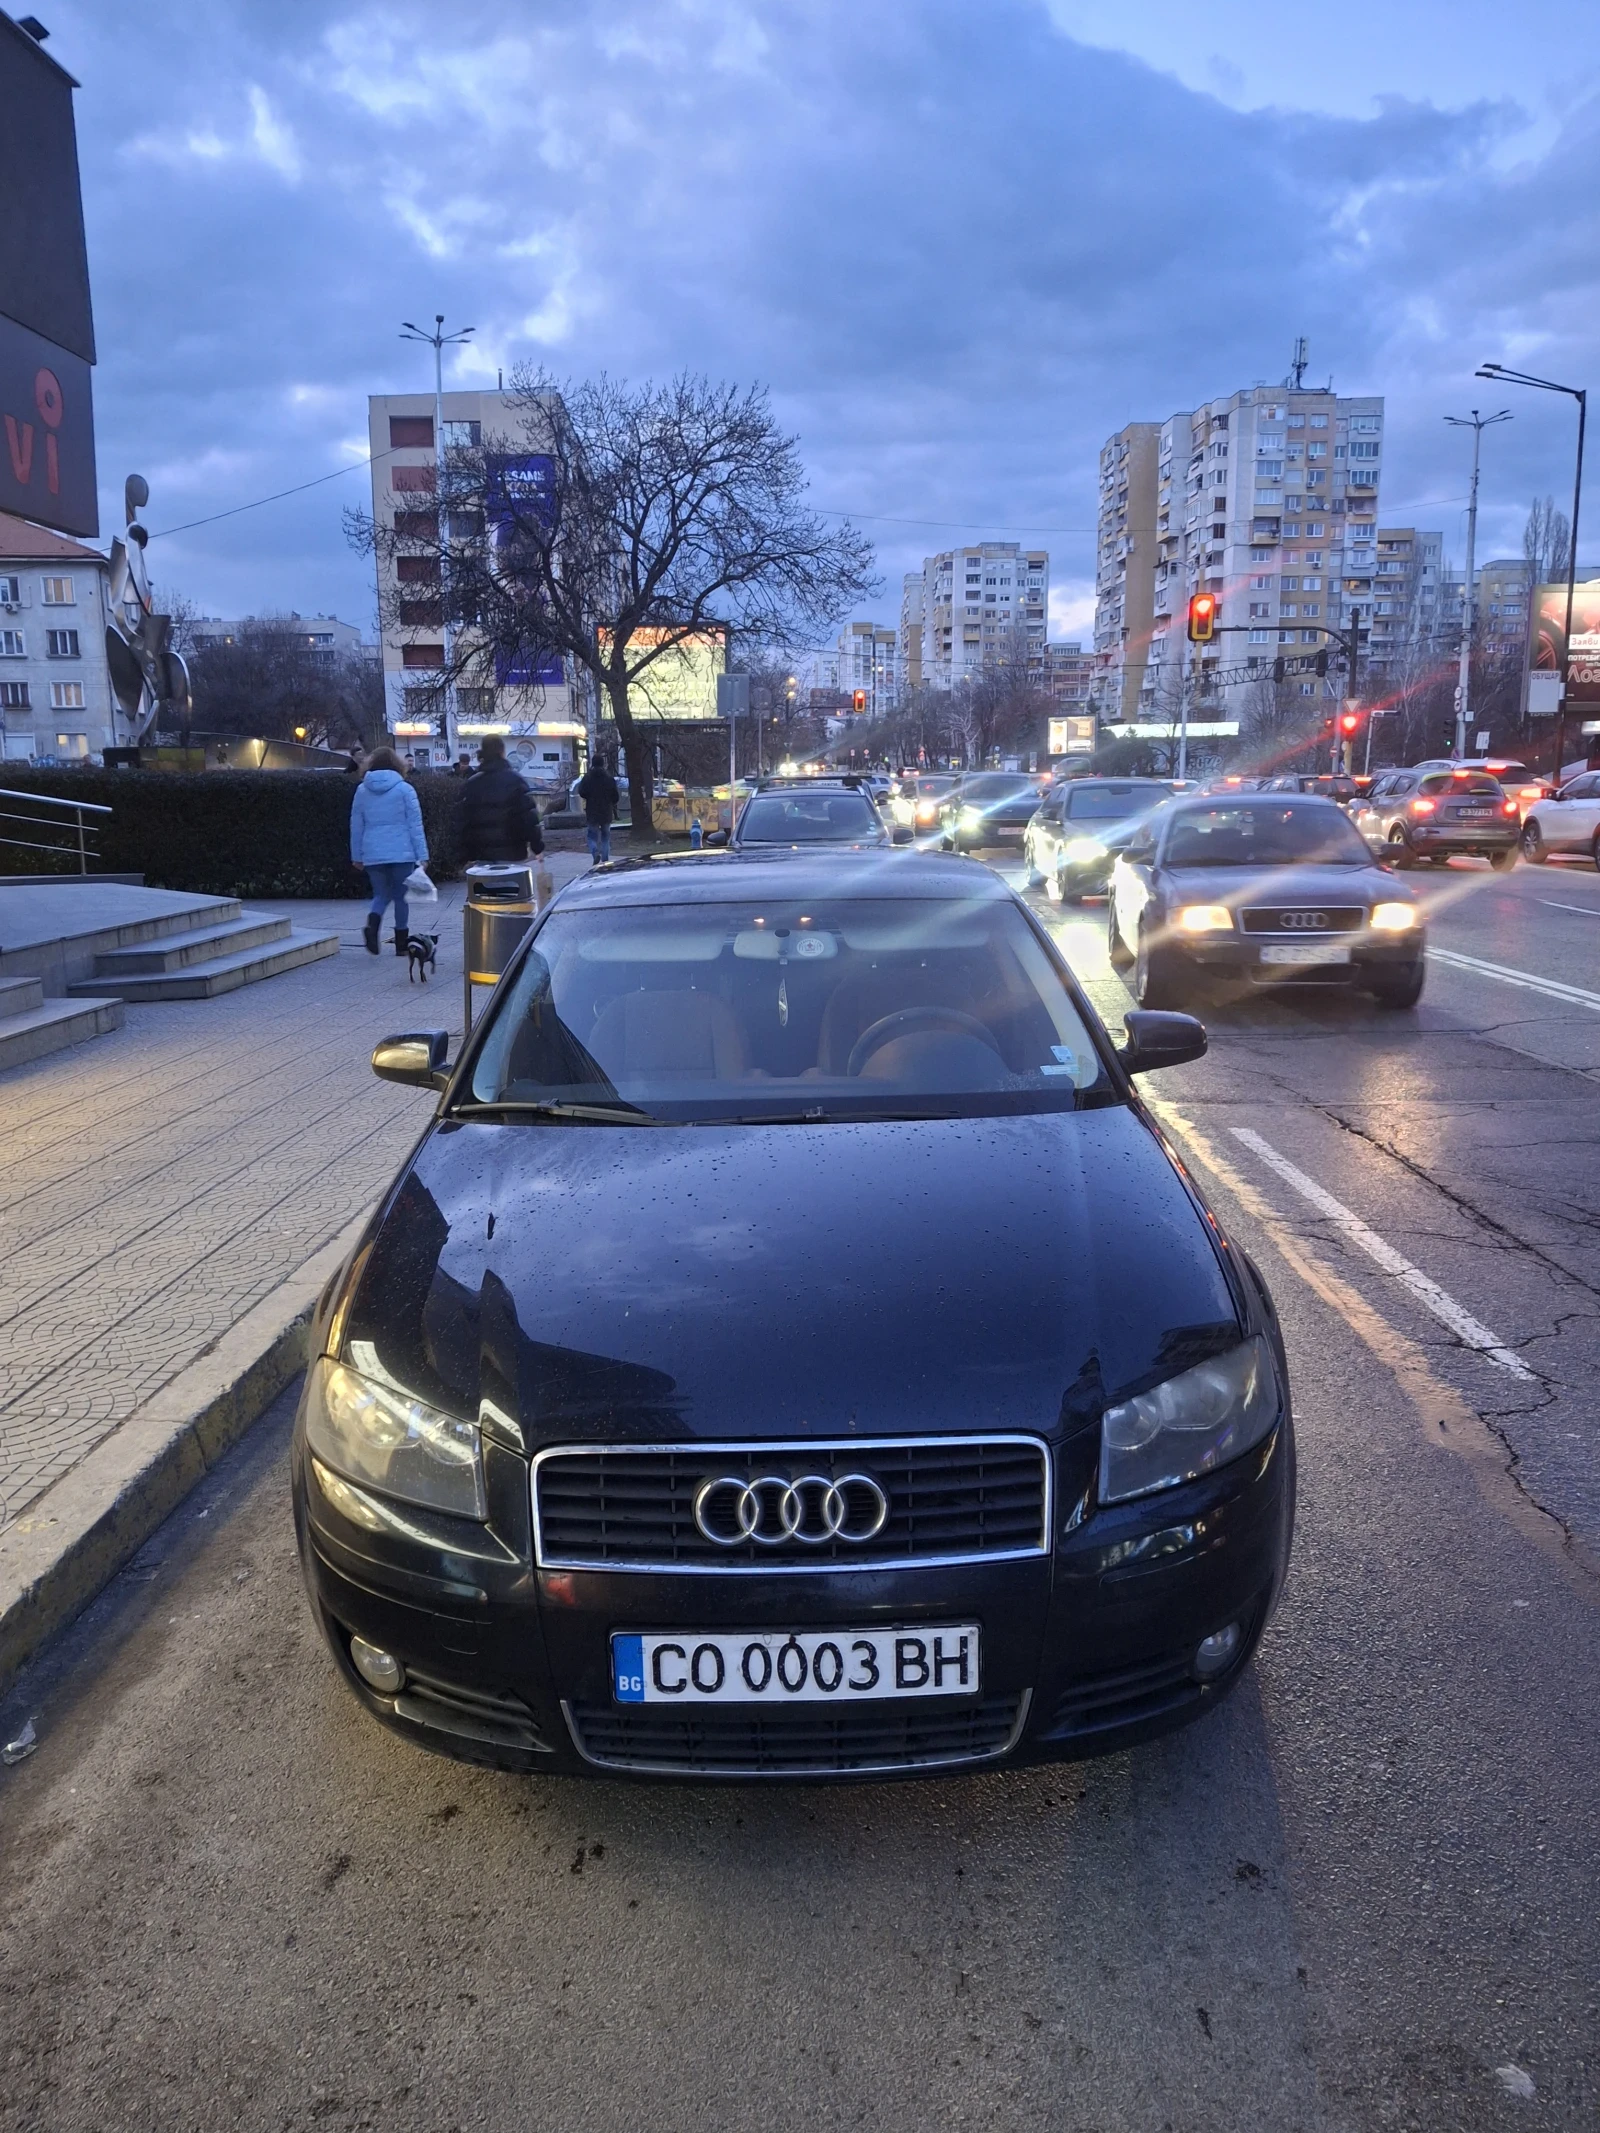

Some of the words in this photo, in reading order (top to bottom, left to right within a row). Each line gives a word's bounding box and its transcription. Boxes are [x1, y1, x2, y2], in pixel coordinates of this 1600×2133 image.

[1531, 672, 1560, 680] ОБУЩАР
[652, 1643, 725, 1694] CO
[741, 1640, 880, 1693] 0003
[895, 1636, 969, 1688] BH
[619, 1675, 642, 1692] BG
